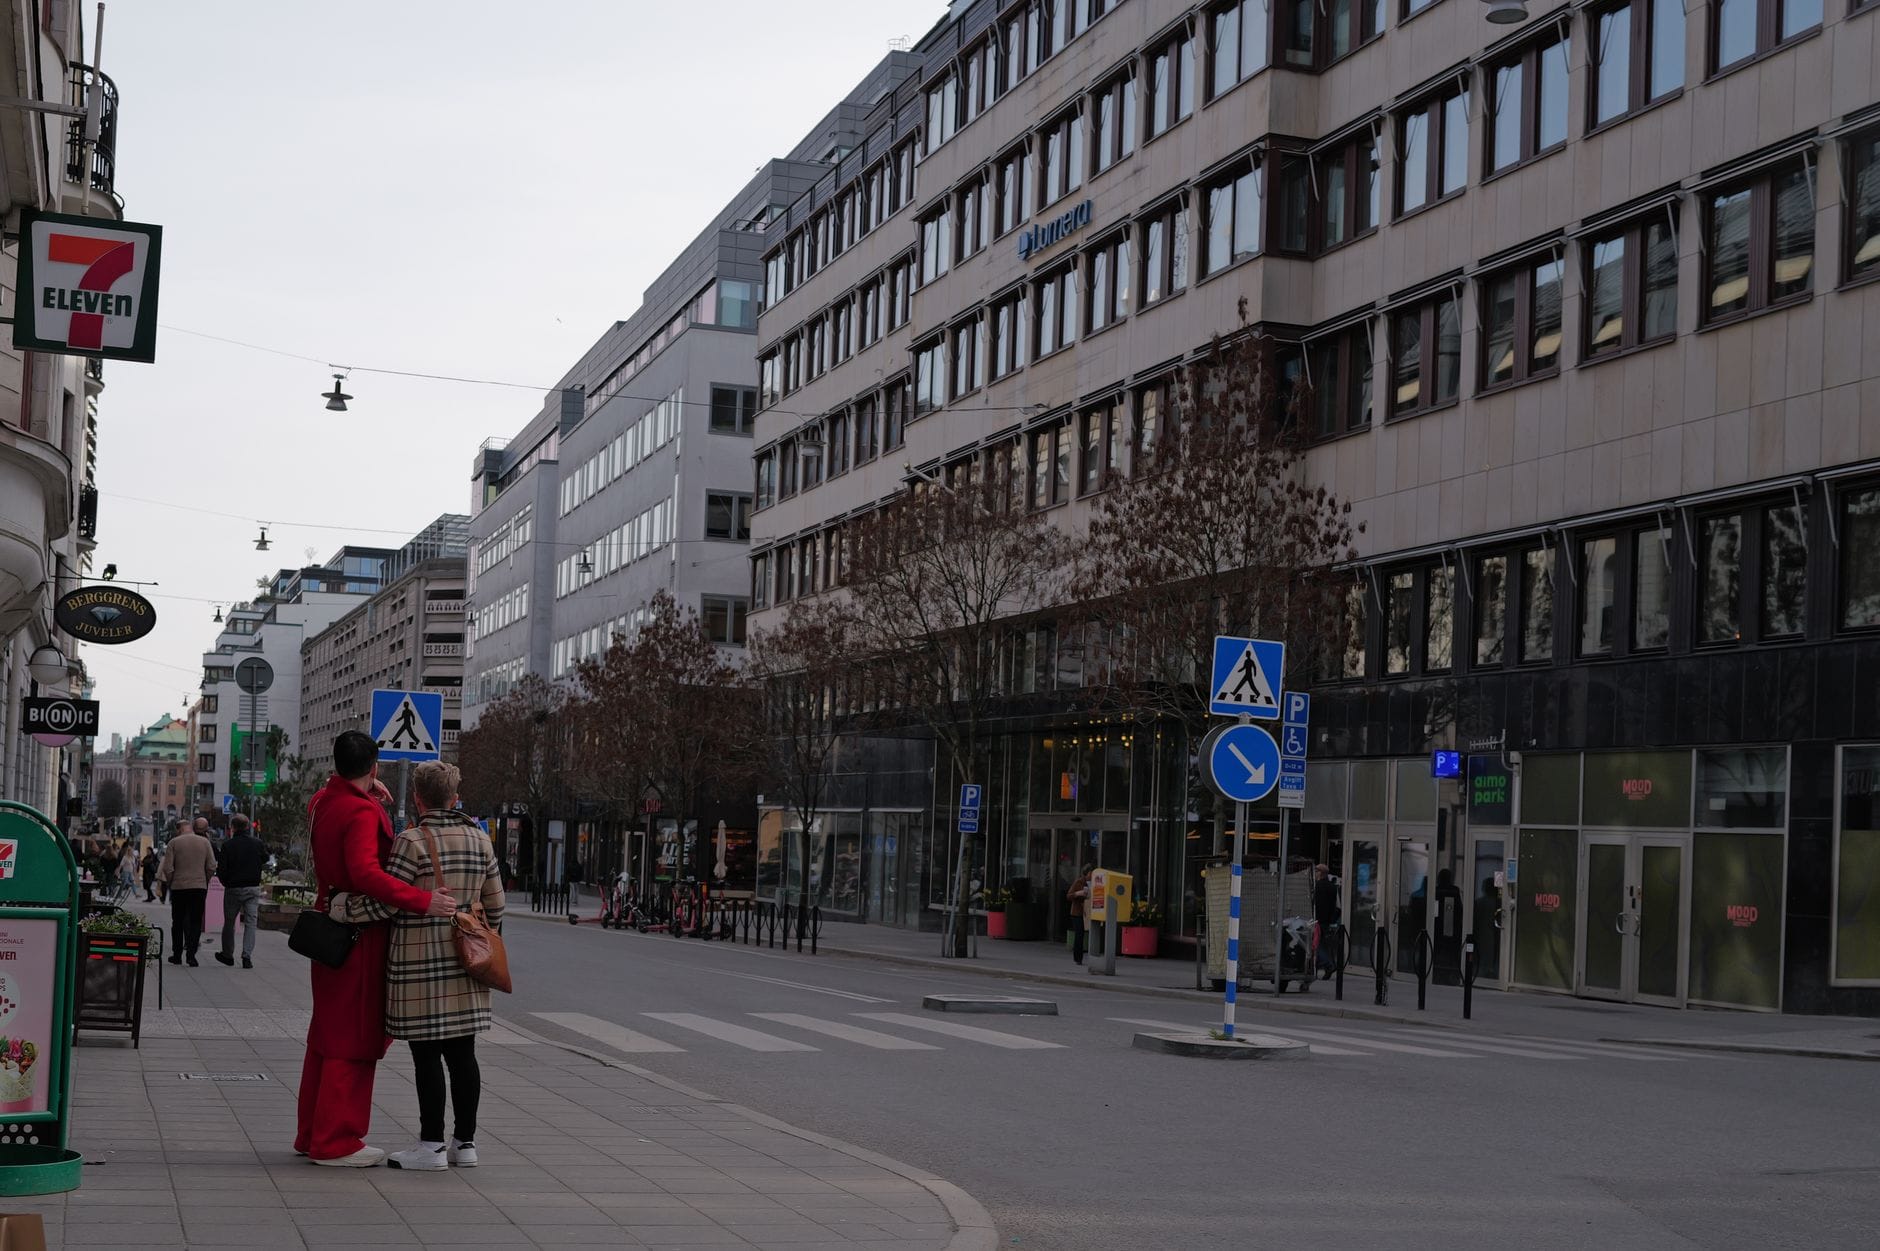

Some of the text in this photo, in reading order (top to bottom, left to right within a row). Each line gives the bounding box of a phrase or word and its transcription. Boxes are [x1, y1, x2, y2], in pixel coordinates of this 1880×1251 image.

[1031, 200, 1092, 252] Lumera
[48, 234, 134, 349] 7
[66, 592, 147, 616] BERGGRENS
[76, 622, 133, 637] JUVELER
[29, 706, 94, 726] BIONIC
[1290, 695, 1305, 721] P
[1475, 775, 1506, 787] aimo
[1622, 779, 1652, 794] MOOD
[966, 787, 977, 806] P
[1474, 789, 1505, 806] park
[1535, 893, 1560, 907] MOOD
[1727, 906, 1758, 922] MOOD
